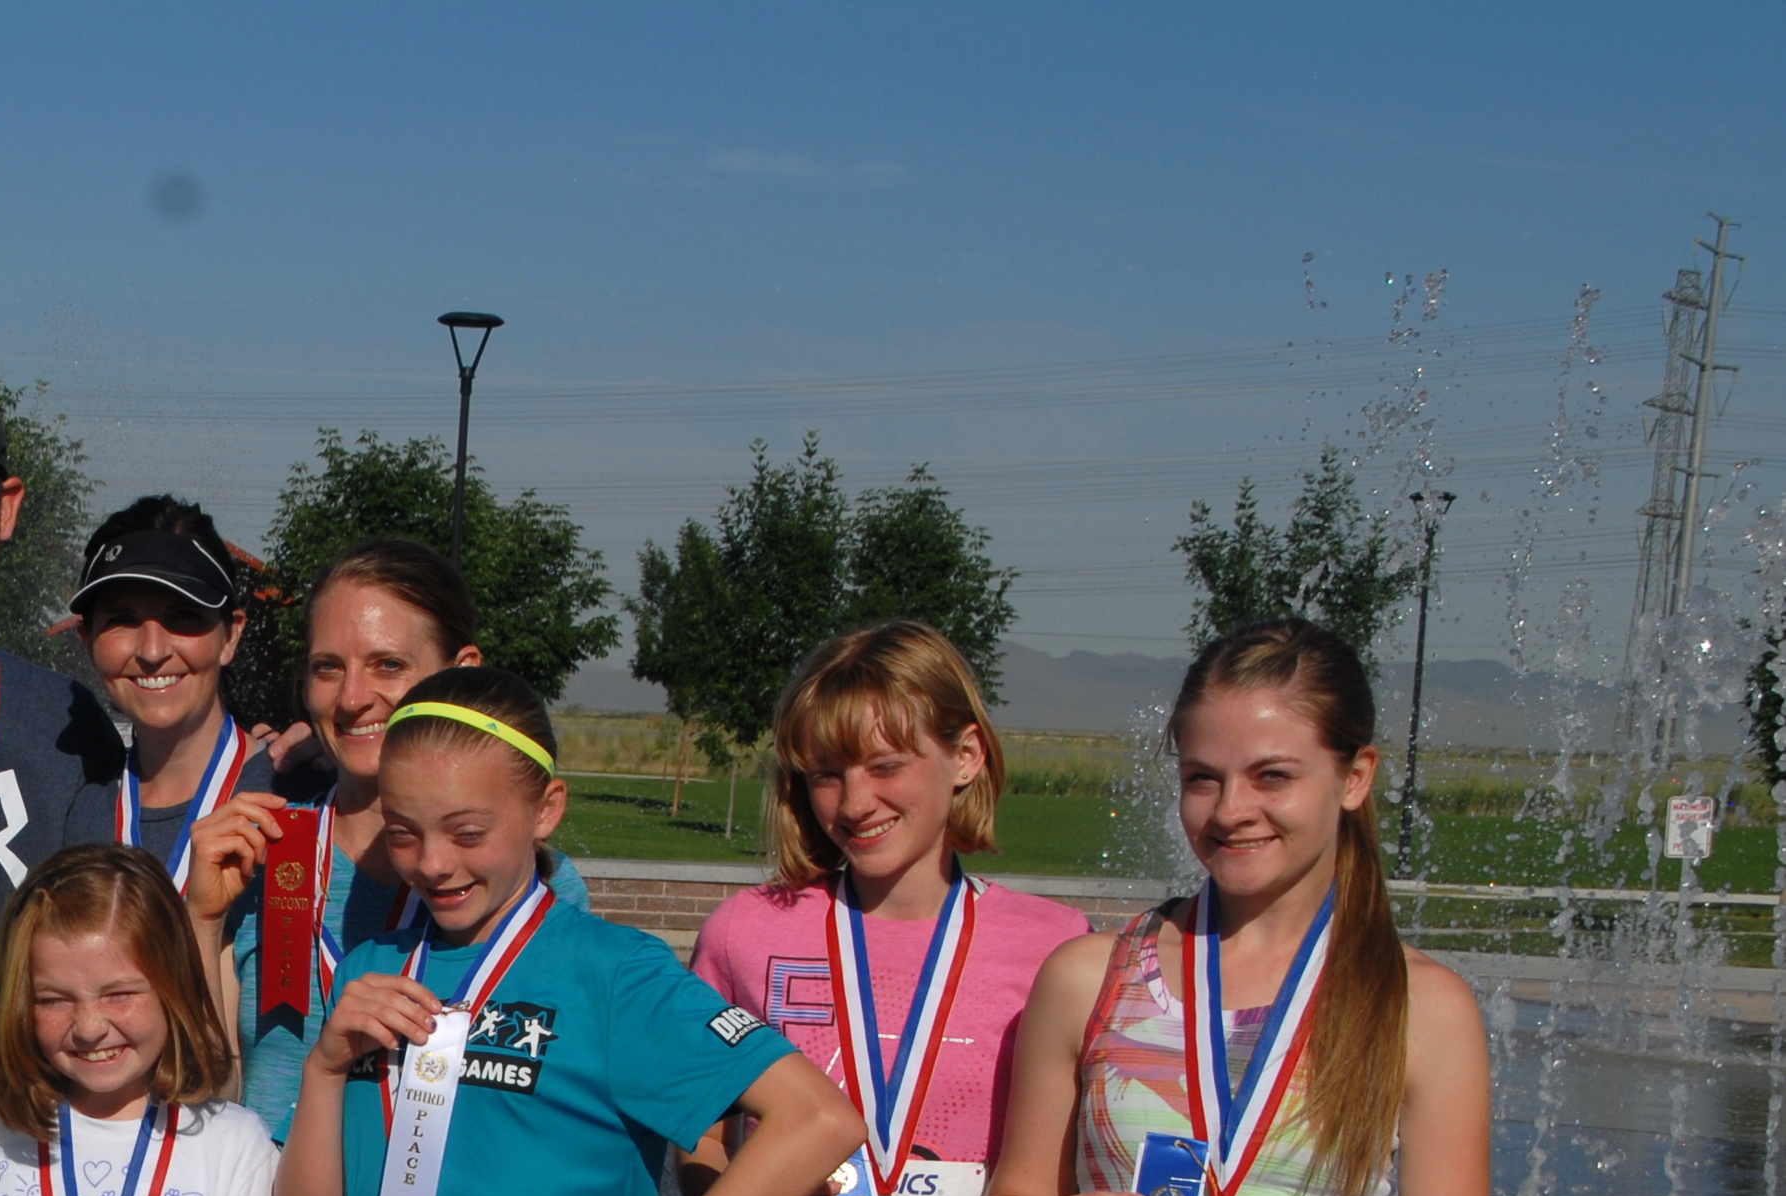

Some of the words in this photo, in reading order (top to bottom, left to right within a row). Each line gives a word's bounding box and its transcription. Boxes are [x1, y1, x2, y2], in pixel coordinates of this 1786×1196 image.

[268, 896, 309, 911] SECOND
[279, 916, 293, 989] PLACE
[405, 1087, 445, 1106] THIRD
[403, 1109, 427, 1185] PLACE
